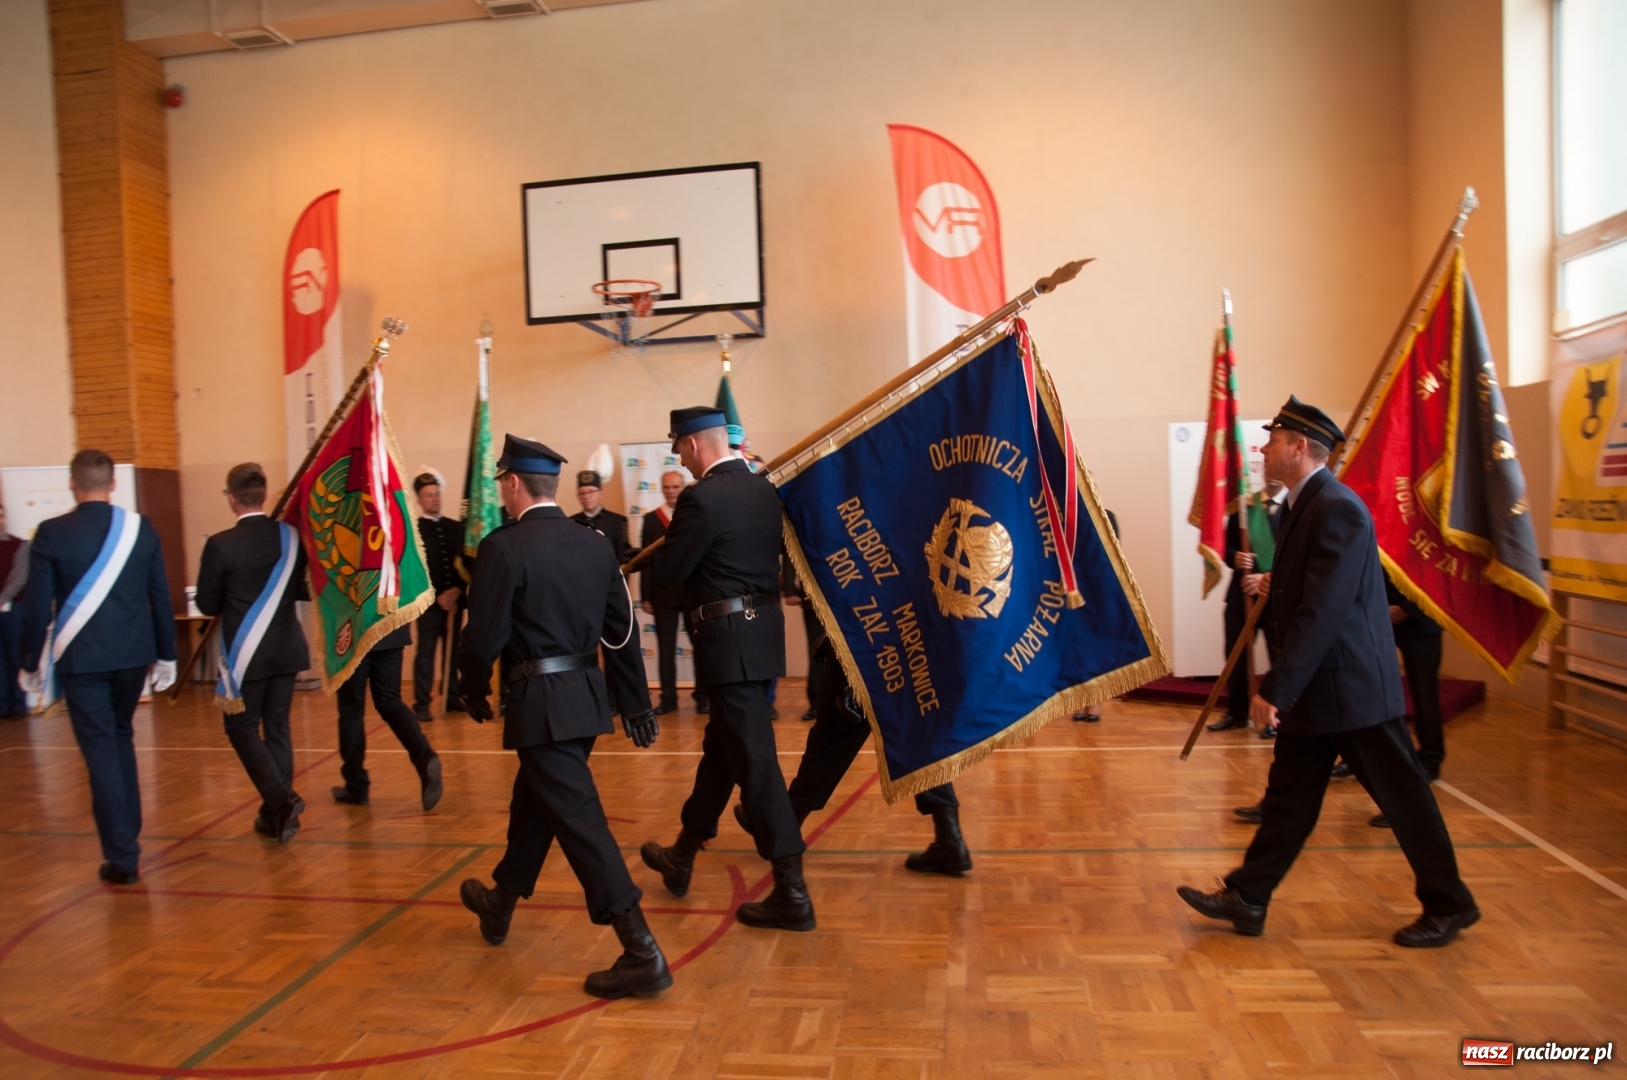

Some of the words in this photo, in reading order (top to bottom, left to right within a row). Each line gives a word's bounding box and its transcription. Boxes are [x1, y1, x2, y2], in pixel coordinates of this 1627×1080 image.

[929, 434, 1028, 484] OCHOTNICZA
[836, 496, 900, 586] RACIBÓRZ
[891, 601, 940, 717] MARKOWICE
[1434, 552, 1458, 577] ZA
[825, 547, 863, 589] ROK
[876, 645, 905, 693] 1903
